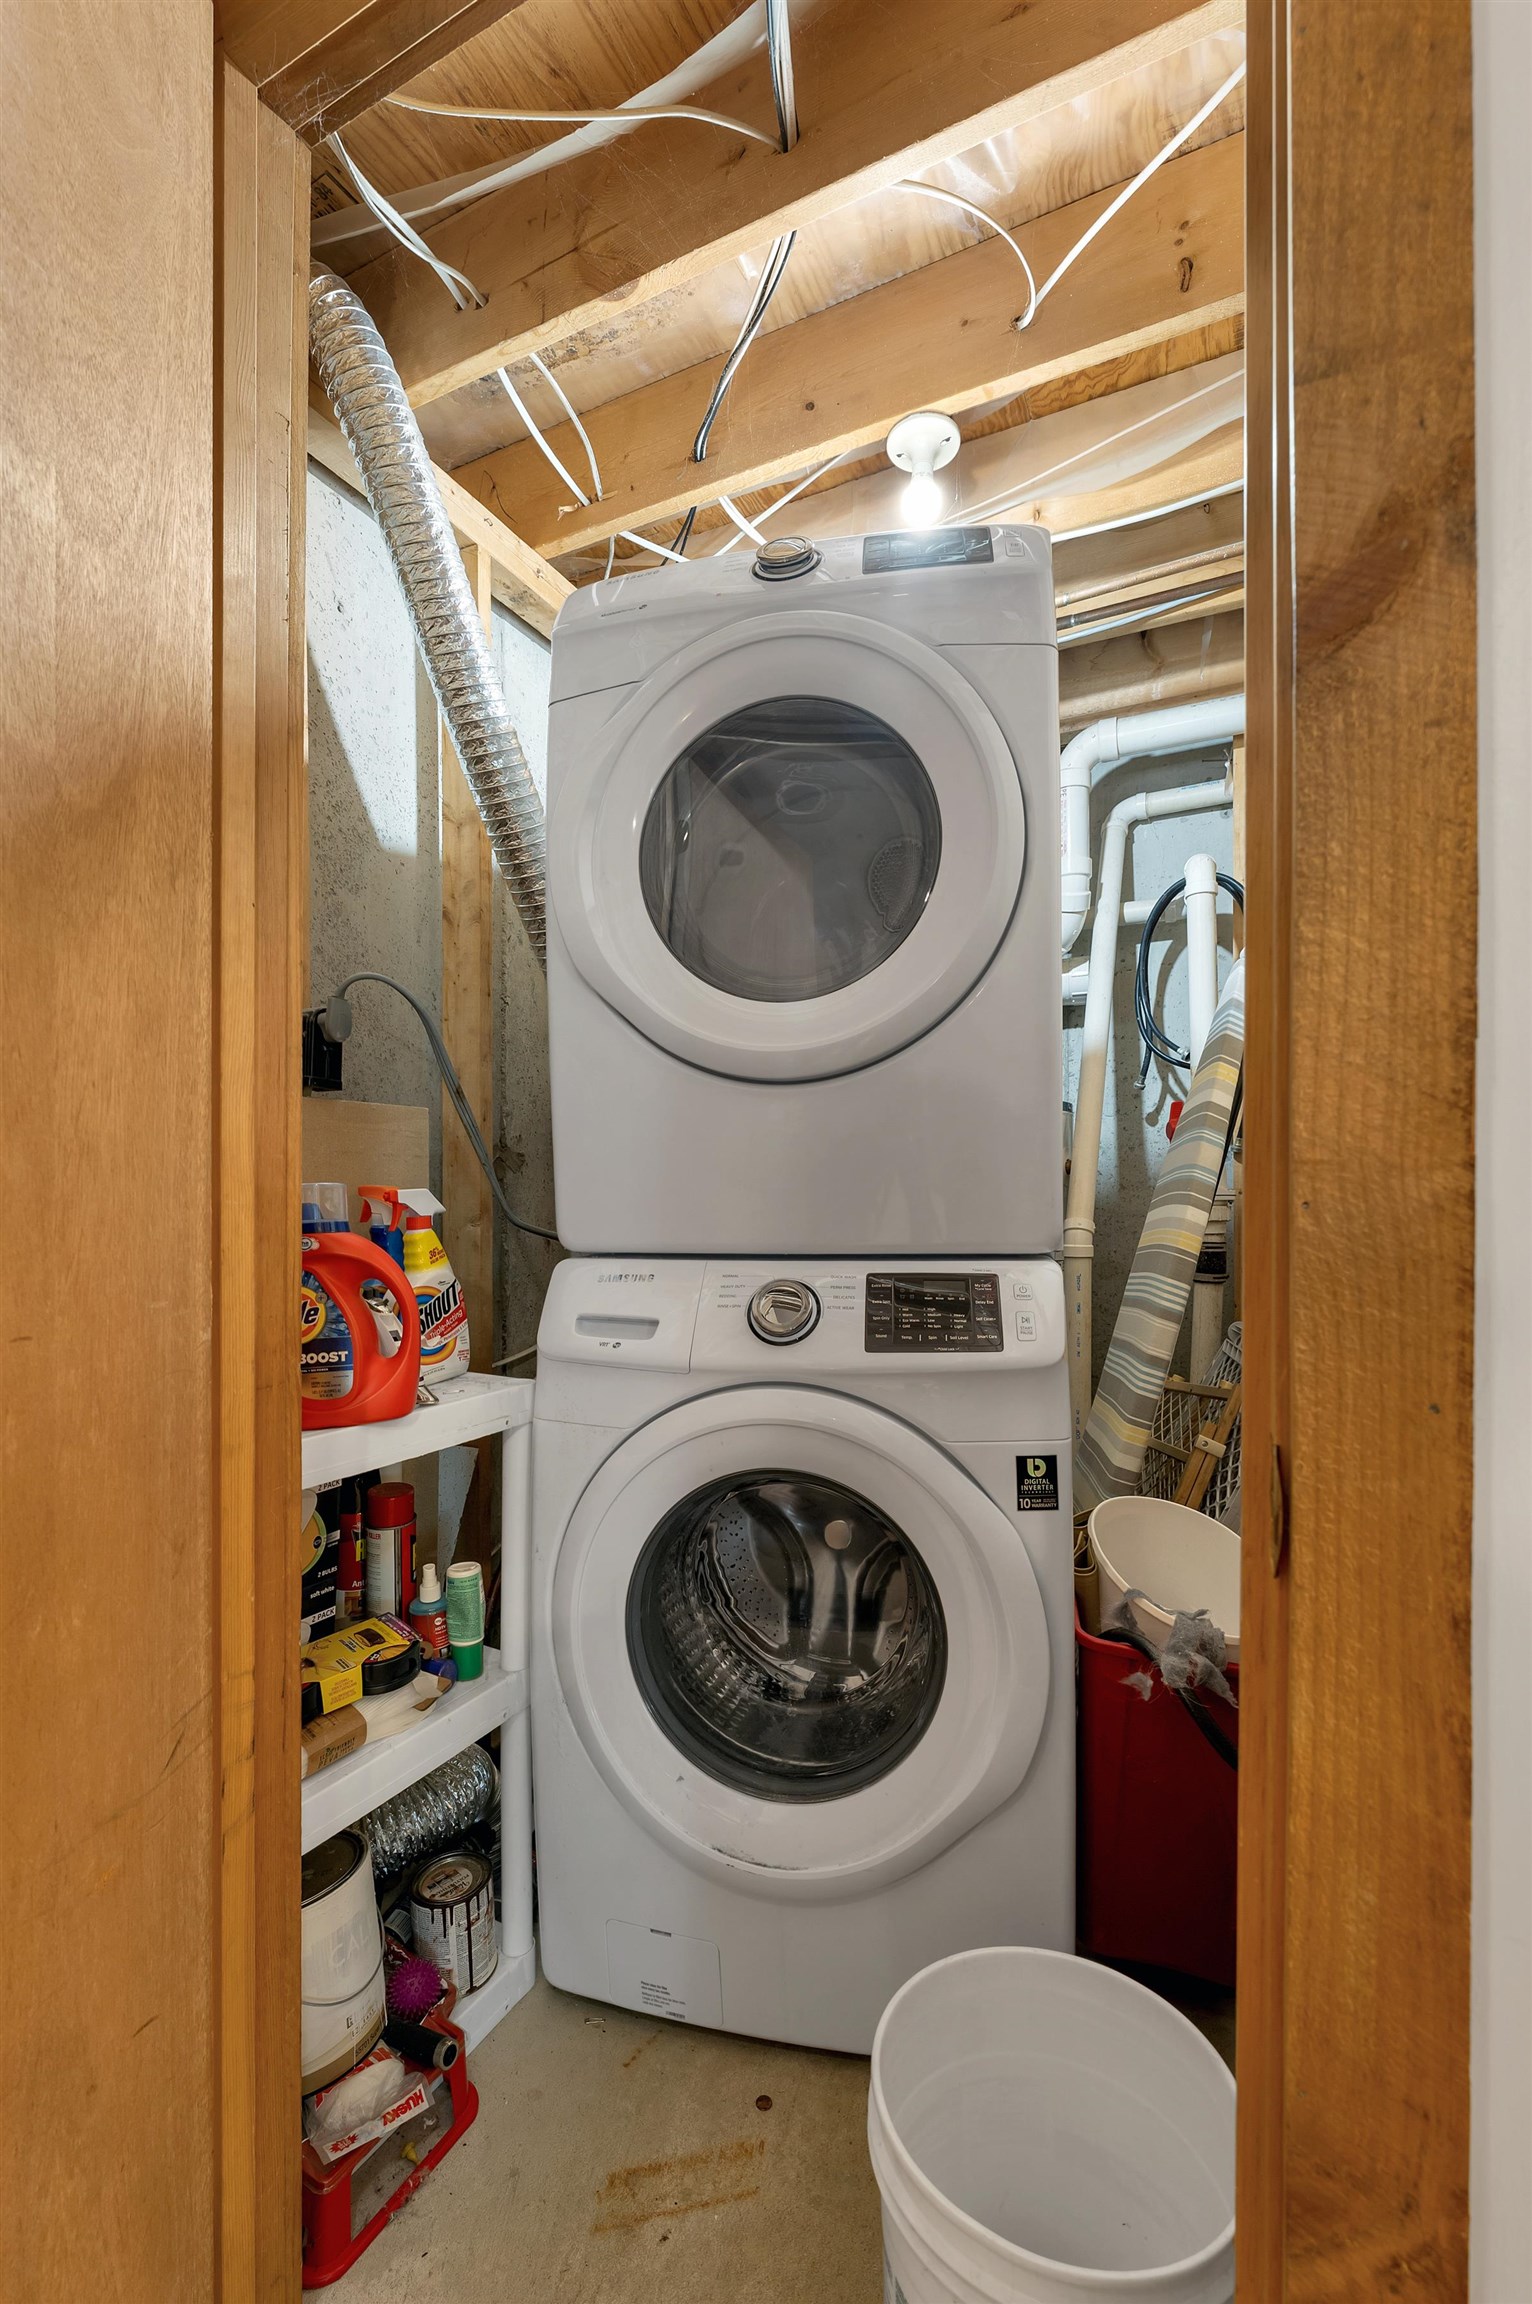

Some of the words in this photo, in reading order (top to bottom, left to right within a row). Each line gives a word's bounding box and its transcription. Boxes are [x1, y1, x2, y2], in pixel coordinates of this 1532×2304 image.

[598, 1274, 654, 1283] SAMSUNG
[324, 1479, 341, 1489] PACK
[1019, 1498, 1030, 1508] 10
[322, 1566, 338, 1576] BULBS
[310, 1590, 320, 1599] soft
[321, 1586, 335, 1595] white
[317, 1608, 335, 1620] PACK
[382, 2088, 424, 2126] HUSKY
